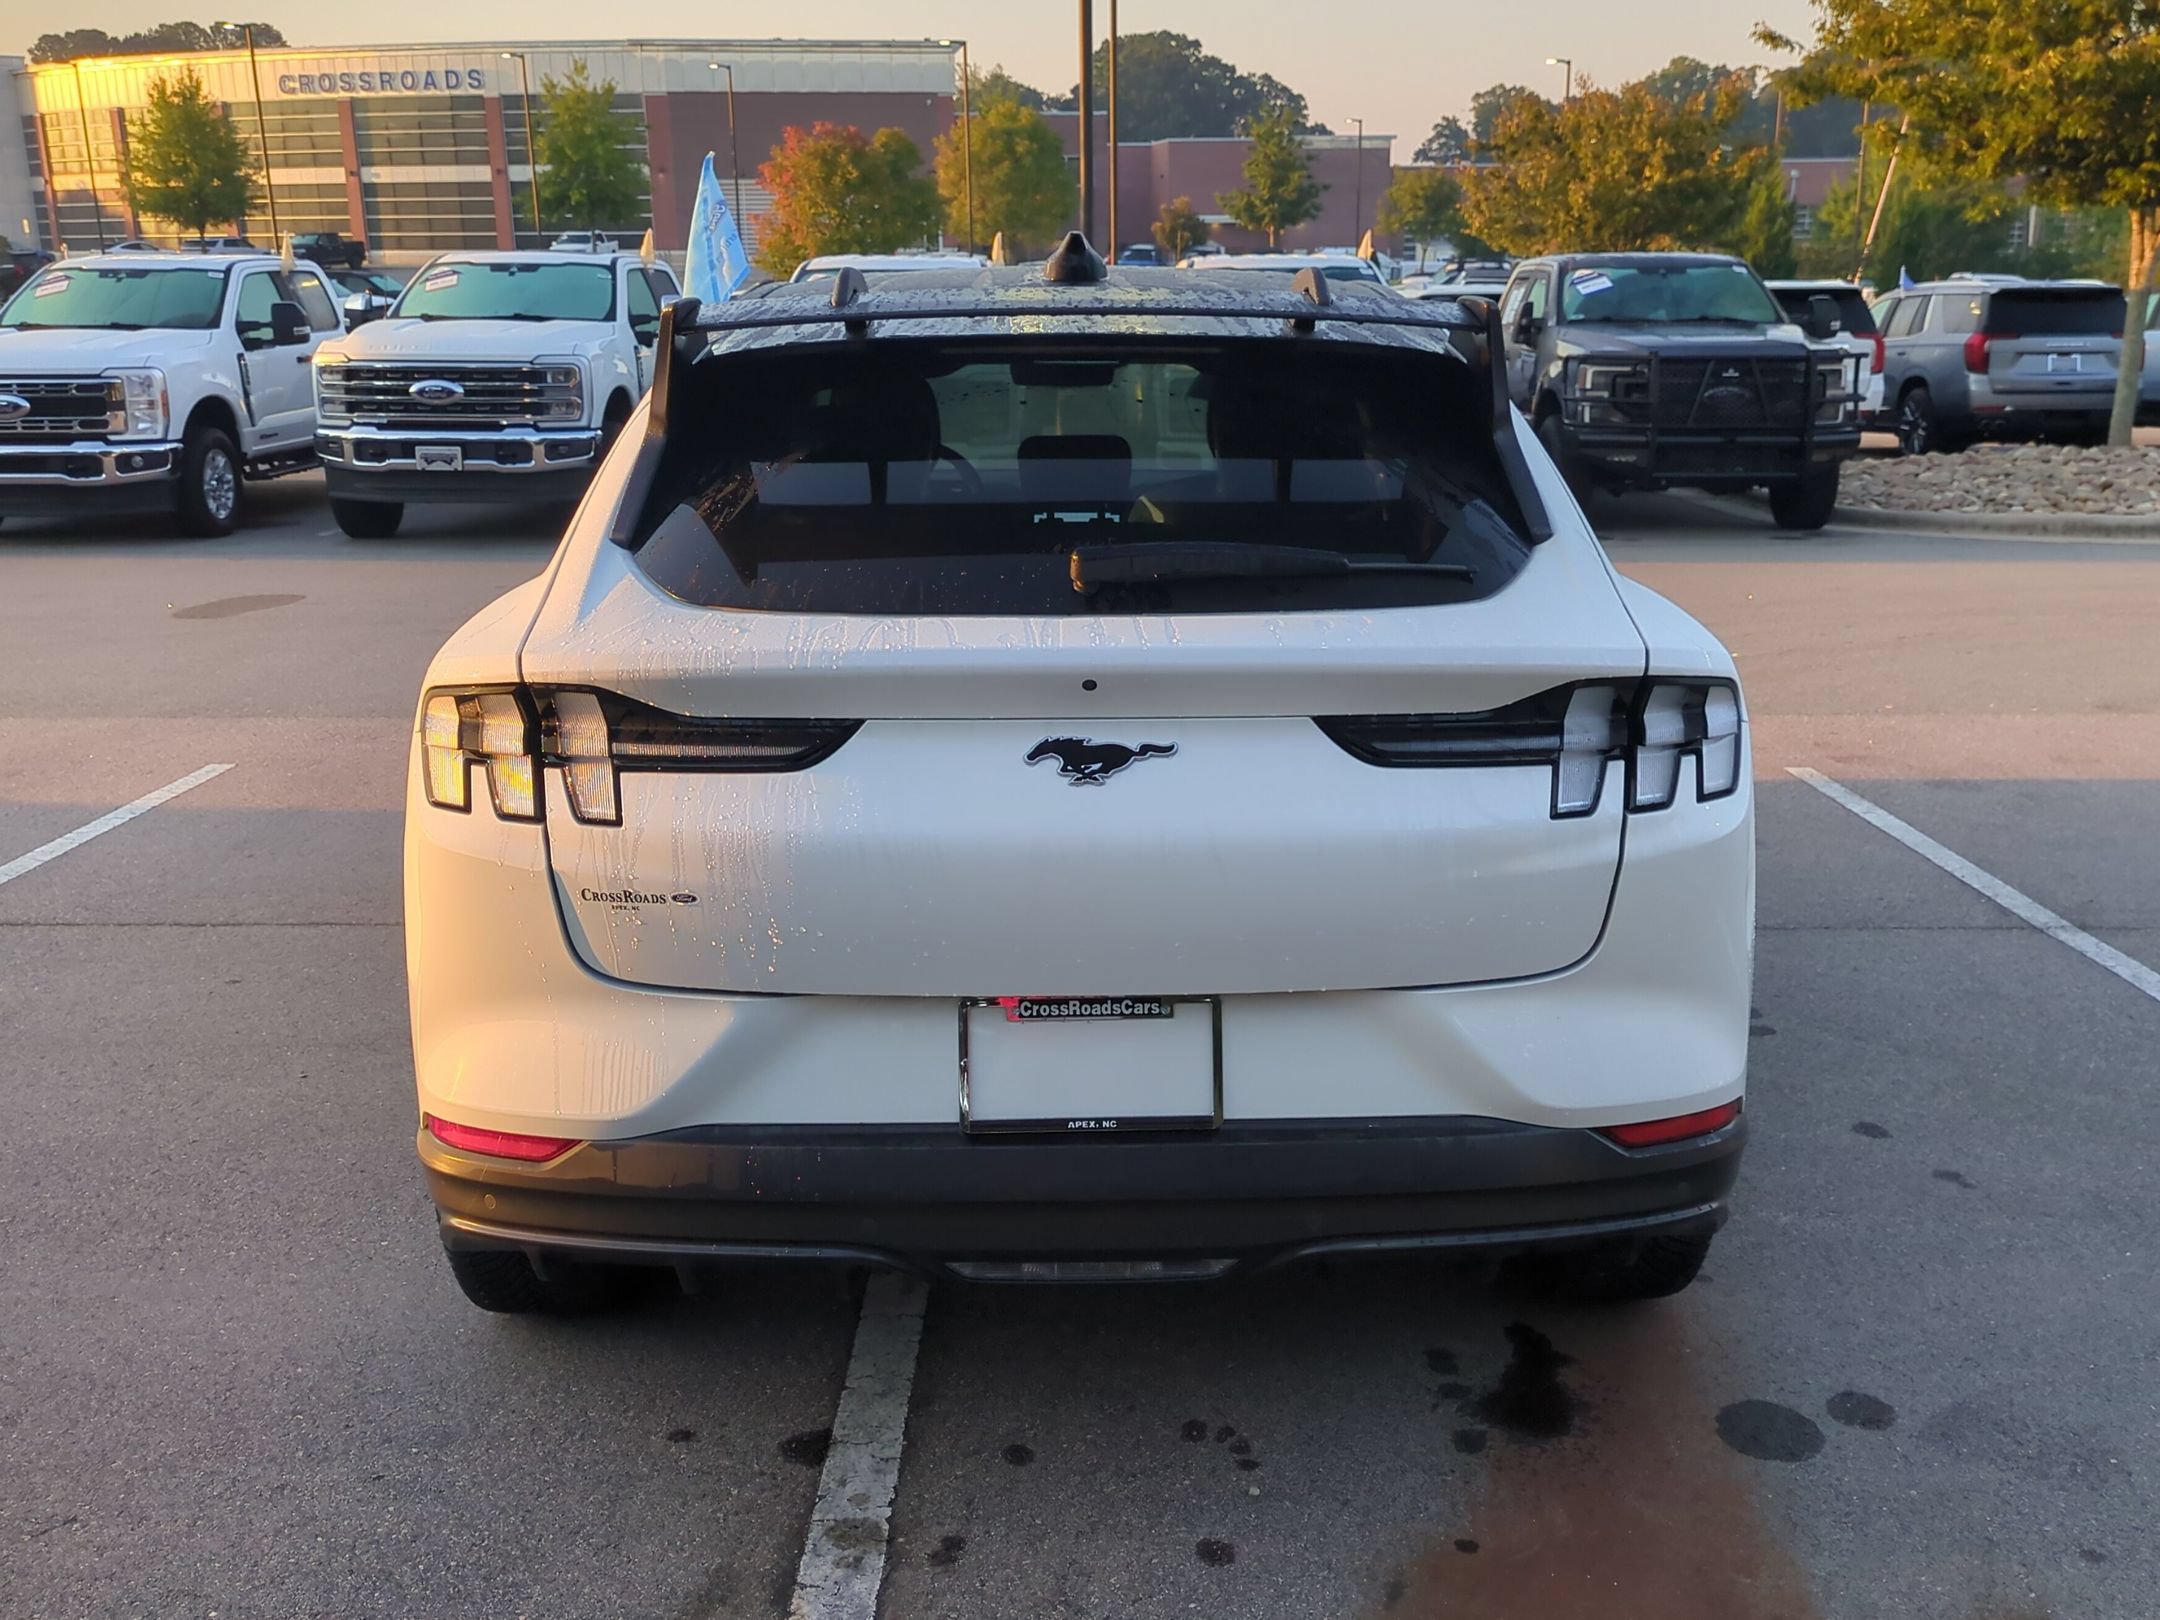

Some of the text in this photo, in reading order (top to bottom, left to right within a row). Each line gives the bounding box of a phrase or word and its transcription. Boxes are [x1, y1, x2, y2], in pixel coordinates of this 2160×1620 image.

[278, 68, 485, 95] CROSSROADS
[1020, 1000, 1160, 1017] CrossRoadsCars
[1067, 1120, 1118, 1129] APEX, NC
